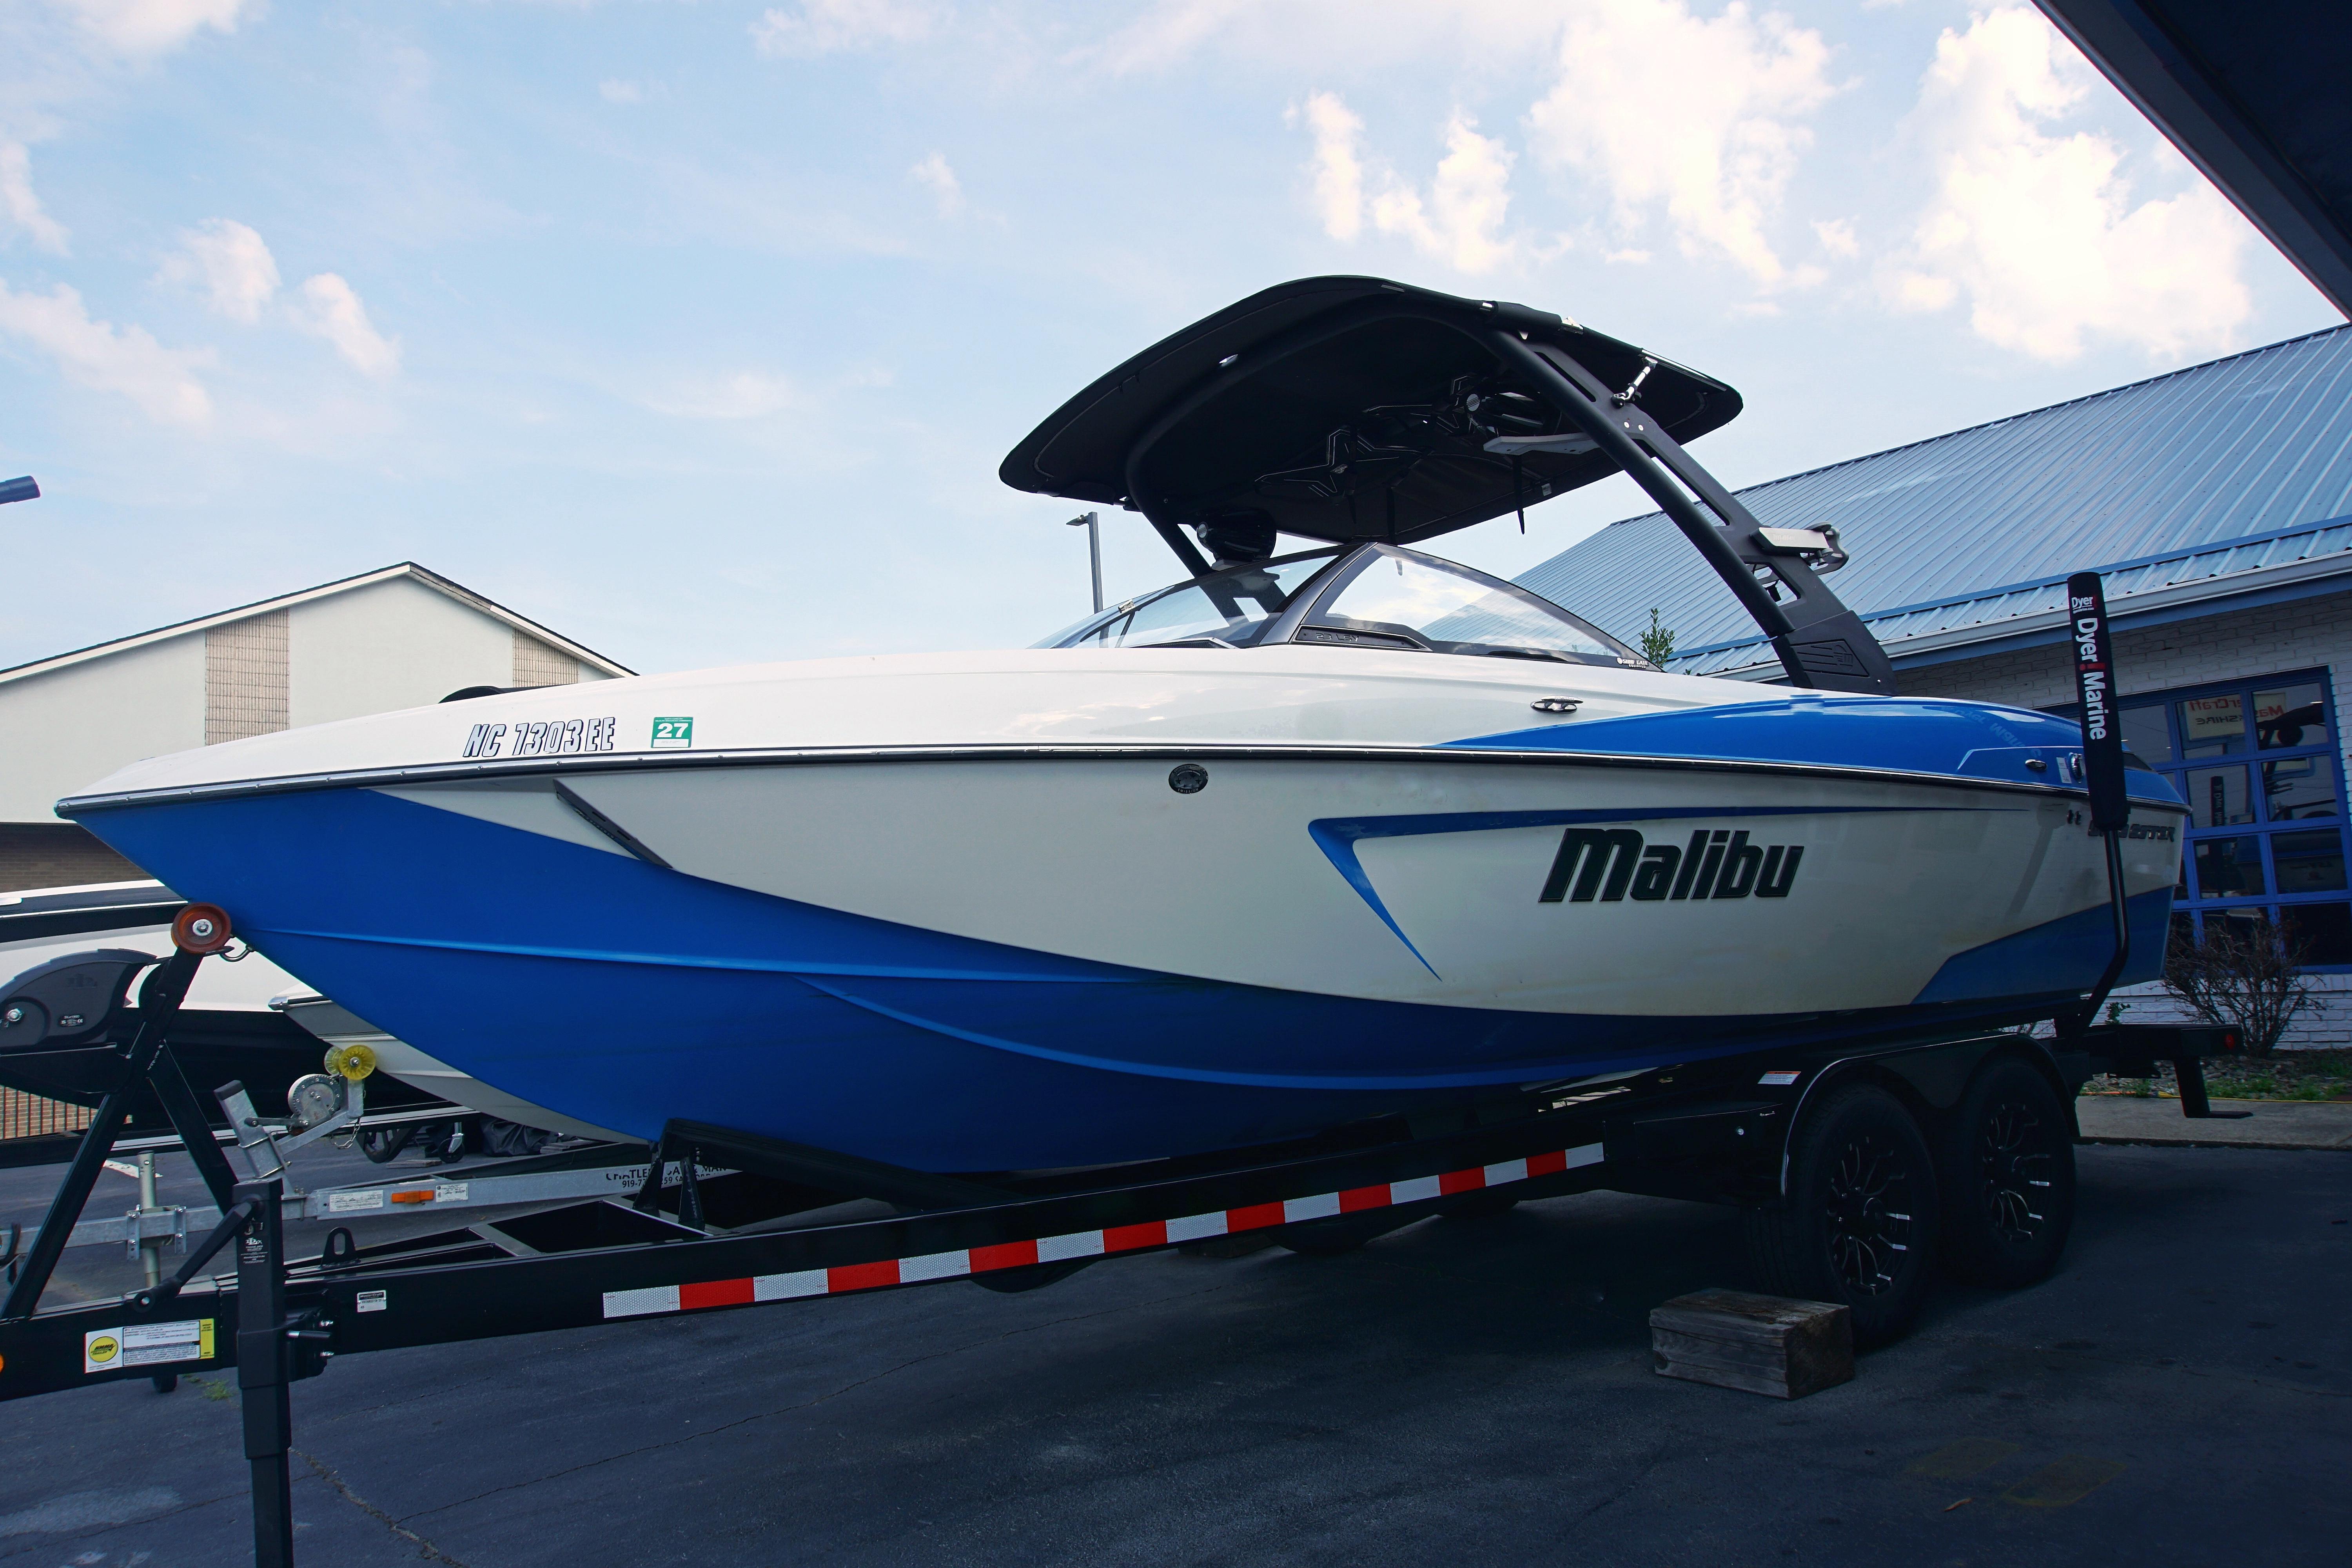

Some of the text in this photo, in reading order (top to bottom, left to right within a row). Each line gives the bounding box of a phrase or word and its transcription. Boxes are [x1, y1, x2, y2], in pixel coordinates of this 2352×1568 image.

[656, 723, 689, 738] 27
[2083, 671, 2109, 740] Marine
[463, 717, 615, 758] NC 7303EE
[1537, 828, 1804, 902] Malibu
